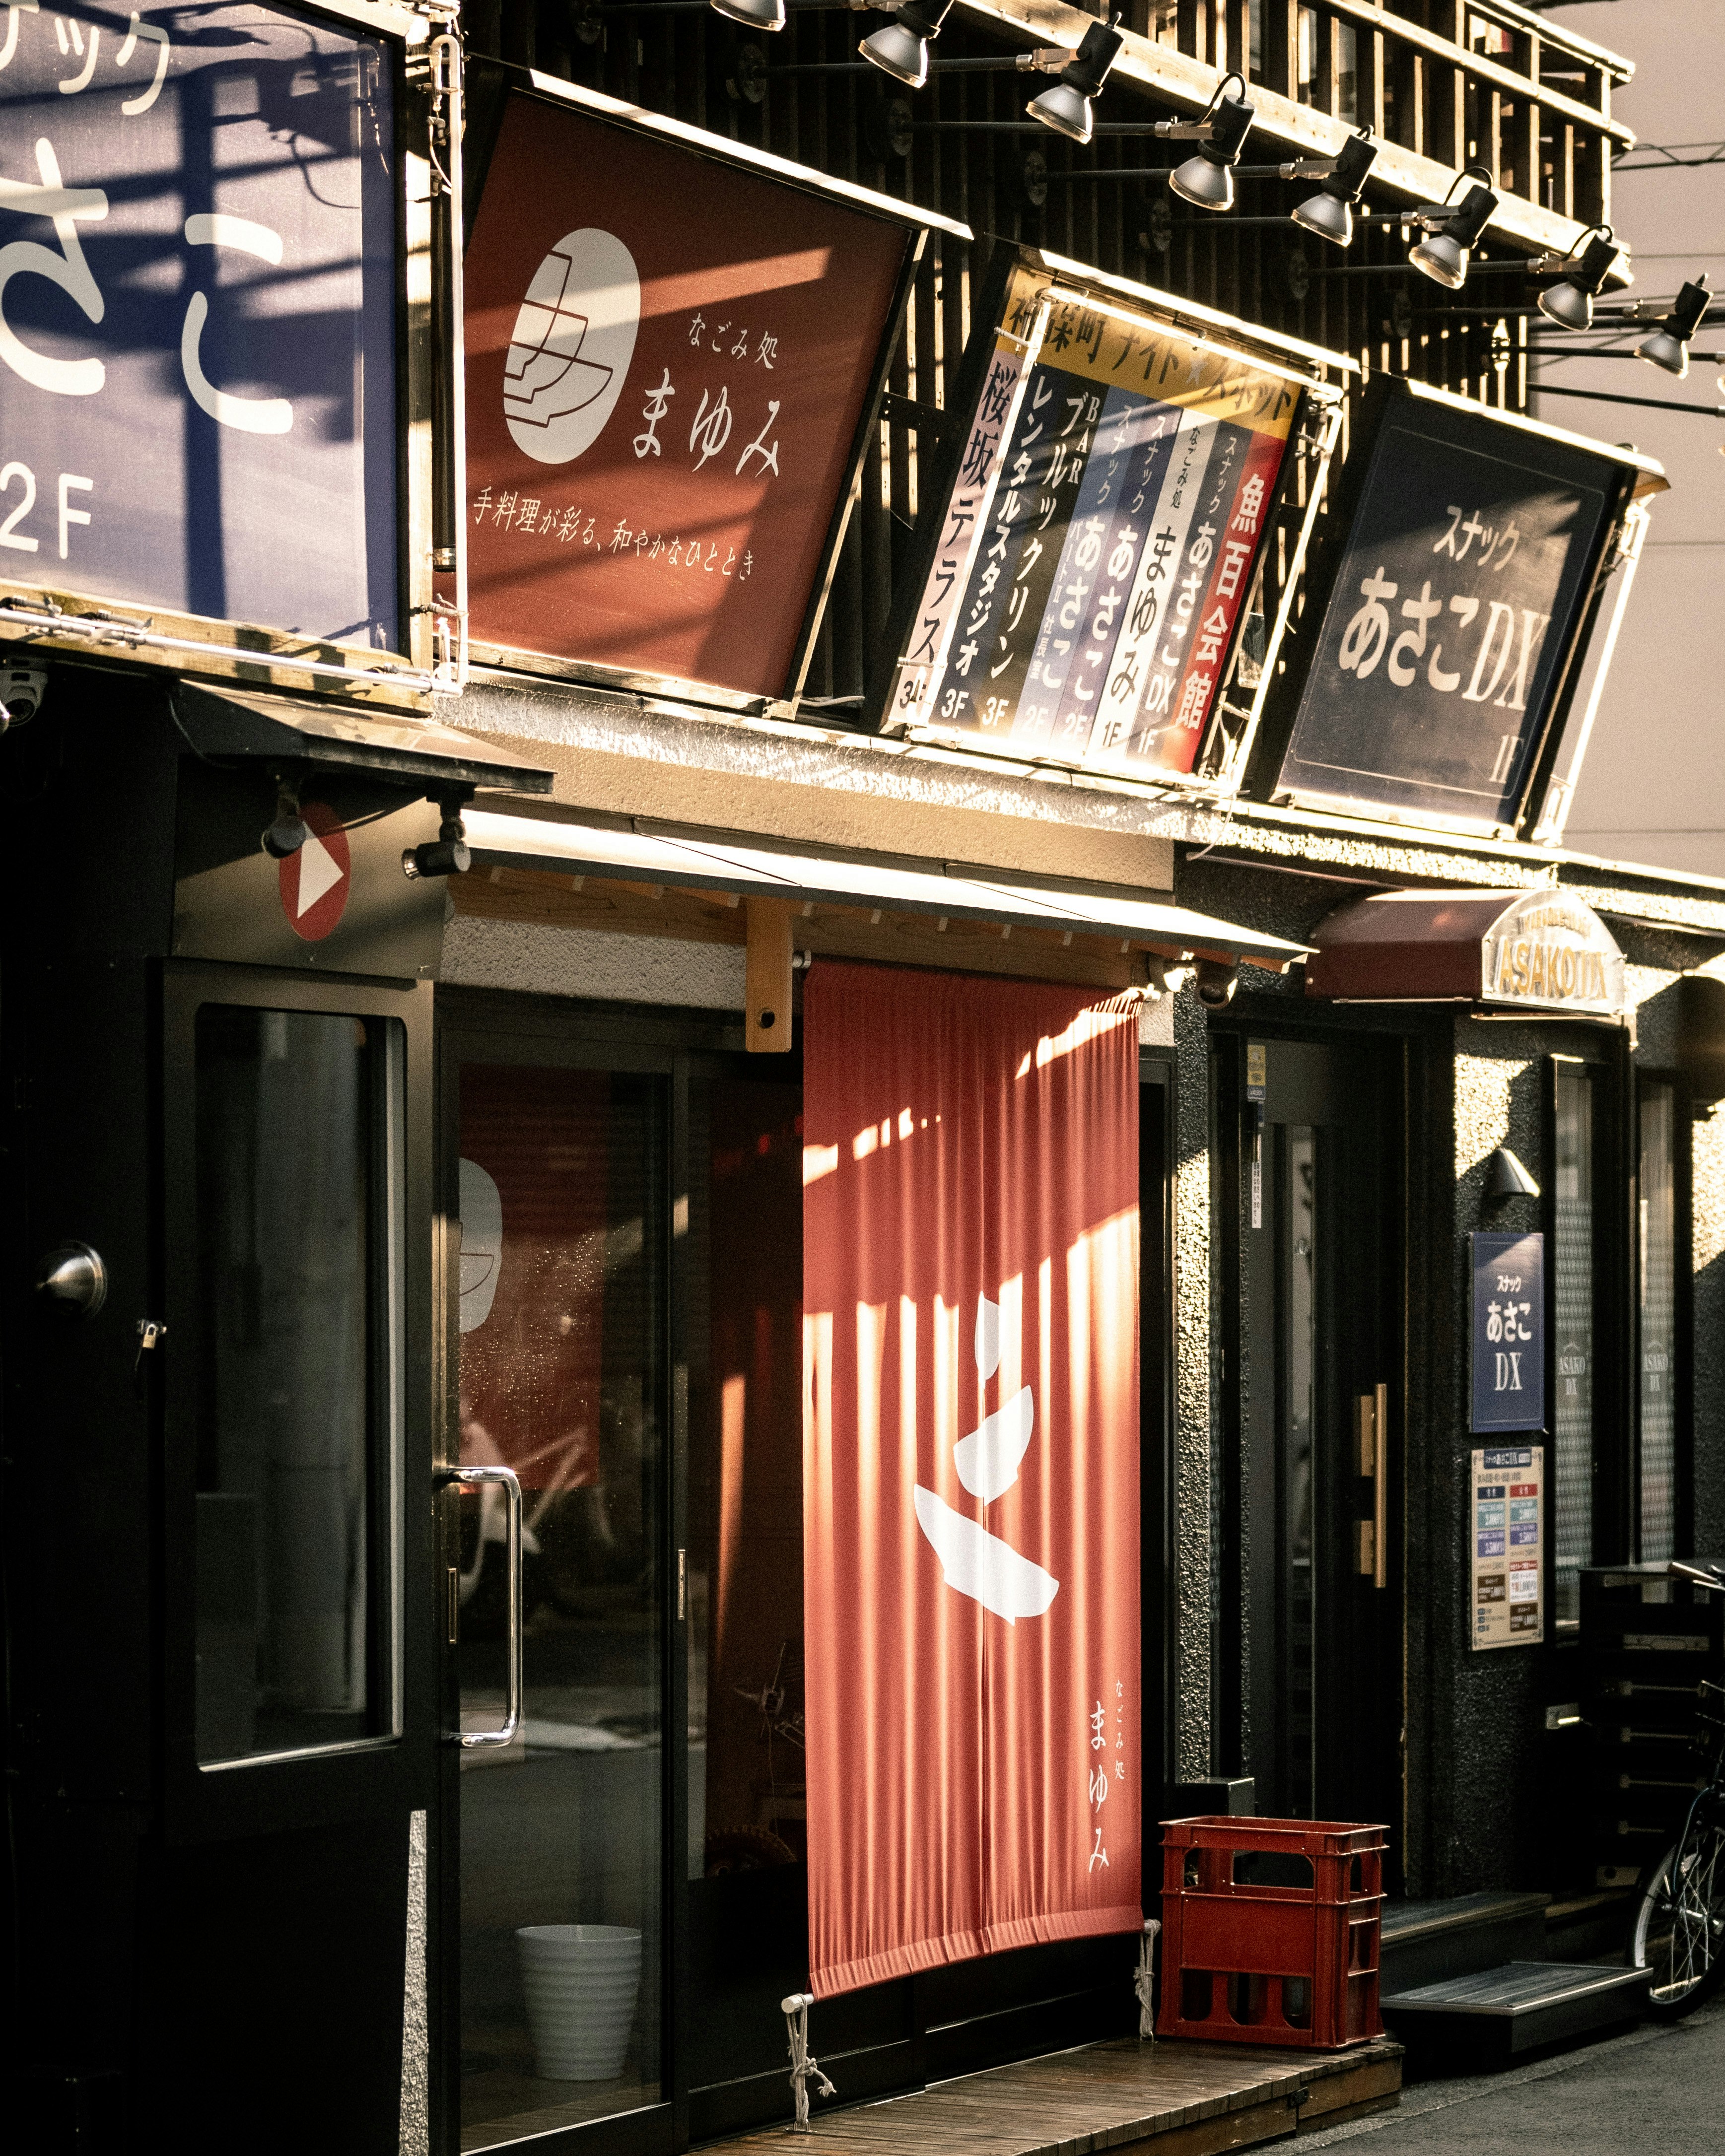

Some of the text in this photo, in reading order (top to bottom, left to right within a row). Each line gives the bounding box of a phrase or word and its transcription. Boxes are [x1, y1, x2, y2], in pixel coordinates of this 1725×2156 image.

[689, 313, 778, 369] なごみ処
[632, 368, 779, 477] まゆみ
[1070, 396, 1100, 485] BAR
[1097, 405, 1132, 505] スナック
[1131, 414, 1166, 514] スナック
[0, 462, 94, 559] 2F
[910, 361, 1017, 663] 桜坂テラス
[1208, 437, 1237, 514] スナック
[955, 375, 1052, 676] レンタルスタジオ
[991, 392, 1089, 679] ブルックリン
[1434, 505, 1521, 571] スナック
[1042, 515, 1105, 689] あさこ
[1074, 524, 1139, 701] あさこ
[1111, 526, 1177, 705] まゆみ
[1176, 472, 1266, 731] 魚百会館
[941, 688, 969, 719] 3F
[982, 696, 1009, 726] 3F
[1023, 705, 1048, 735] 2F
[1062, 712, 1088, 741] 2F
[1103, 721, 1122, 748] 1F
[1137, 727, 1158, 754] 1F
[1489, 735, 1524, 784] 1F
[1487, 1300, 1532, 1343] あさこ
[1497, 1275, 1521, 1292] スナック
[1495, 1352, 1523, 1391] DX
[1557, 1356, 1586, 1375] ASAKO
[1115, 1679, 1125, 1780] なごみ処
[1089, 1700, 1109, 1874] まゆみ
